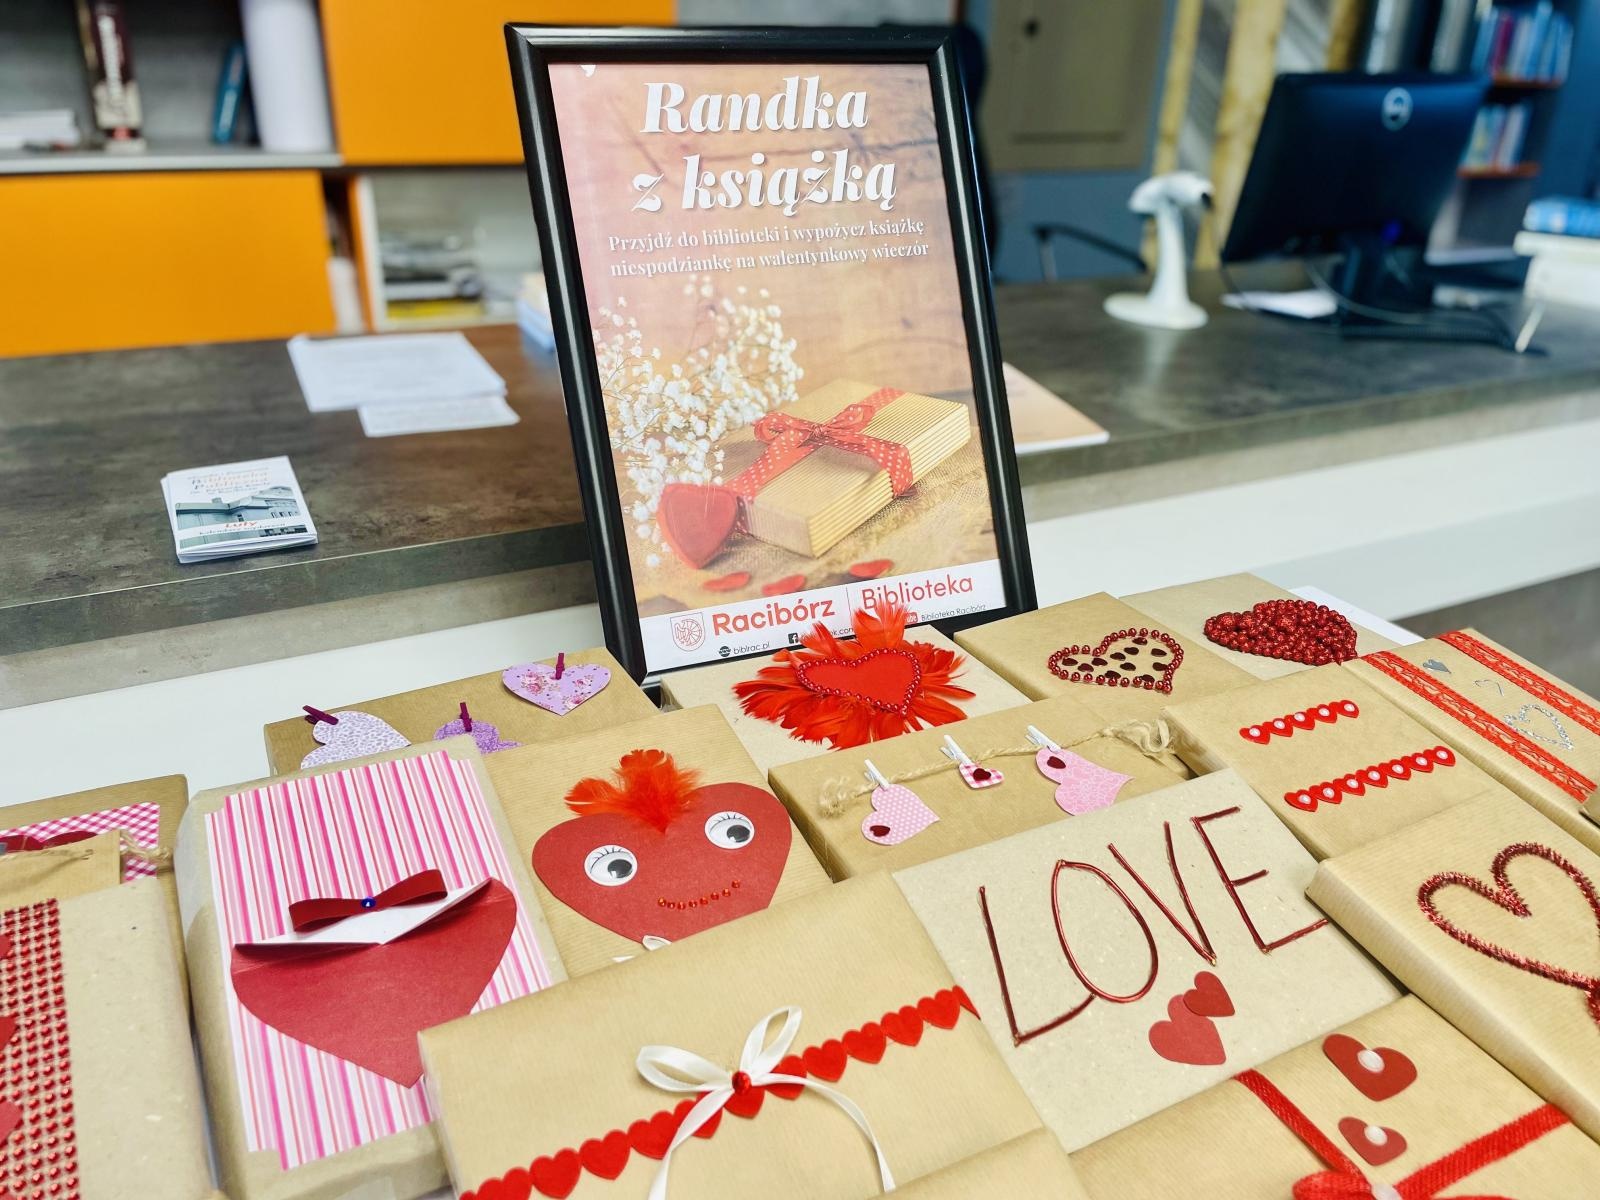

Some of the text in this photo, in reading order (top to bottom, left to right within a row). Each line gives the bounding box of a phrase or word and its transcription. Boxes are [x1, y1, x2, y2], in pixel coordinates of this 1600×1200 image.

[639, 75, 869, 133] Randka
[631, 148, 897, 217] z książką
[608, 216, 925, 252] Przyjdź do biblioteki i wypożycz książkę
[610, 240, 929, 277] niespodziankę na walentynkowy wieczór
[862, 574, 973, 610] Biblioteka
[711, 598, 836, 636] Racibórz
[921, 609, 955, 622] Biblioteka
[956, 603, 986, 617] Racibórz
[976, 805, 1330, 1048] LOVE
